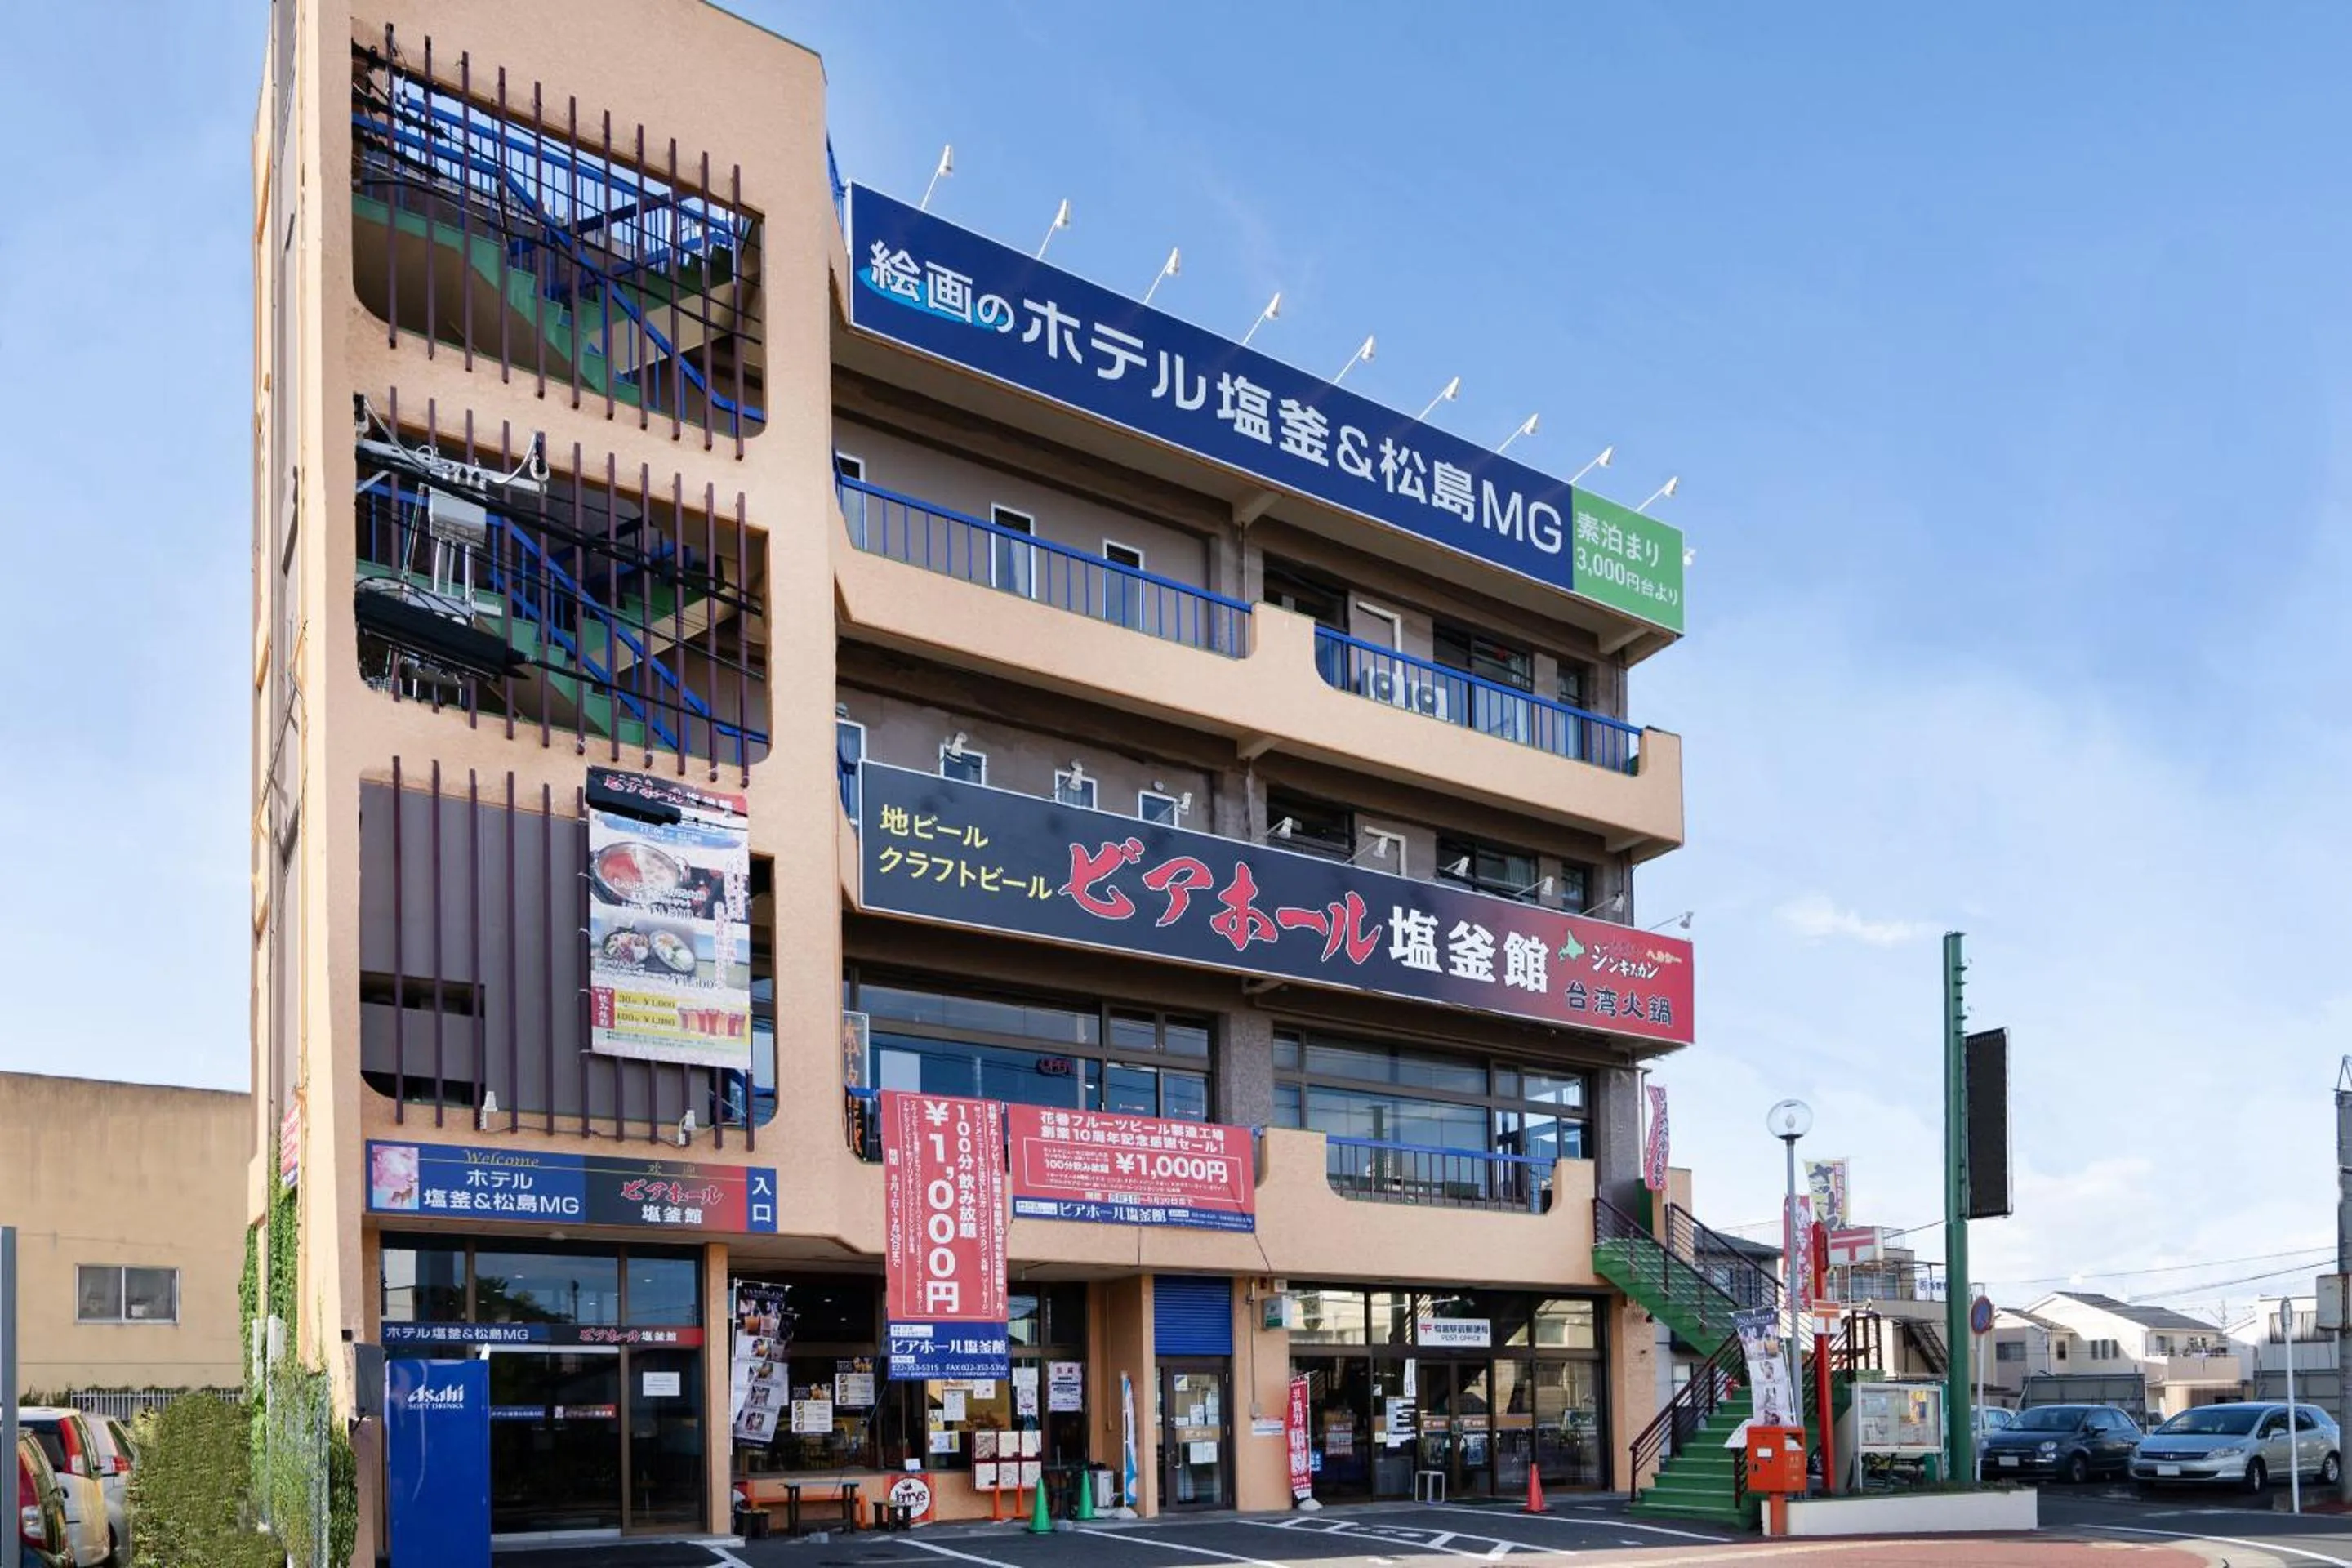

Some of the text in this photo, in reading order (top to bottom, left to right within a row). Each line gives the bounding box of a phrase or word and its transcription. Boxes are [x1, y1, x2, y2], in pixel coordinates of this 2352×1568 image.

[869, 239, 1562, 555] 絵画のホテル塩釜&松島MG
[1576, 511, 1659, 568] 素泊まり
[1576, 546, 1679, 606] 3,000円台より
[879, 804, 989, 850] 地ビール
[879, 846, 1053, 901] クラフトビール
[1566, 979, 1673, 1027] 台湾火鍋
[463, 1148, 540, 1168] Welcome
[1114, 1151, 1229, 1184] ¥1,000円
[466, 1169, 533, 1190] ホテル
[621, 1178, 724, 1205] ビアホール
[423, 1188, 580, 1215] 塩釜&松島MG
[641, 1204, 703, 1224] 塩釜館
[751, 1176, 772, 1223] 入口
[924, 1099, 960, 1314] ¥1,000円
[1059, 1201, 1167, 1223] ビアホール塩釜館
[891, 1339, 1007, 1355] ビアホール塩釜館
[408, 1384, 464, 1403] Asahi
